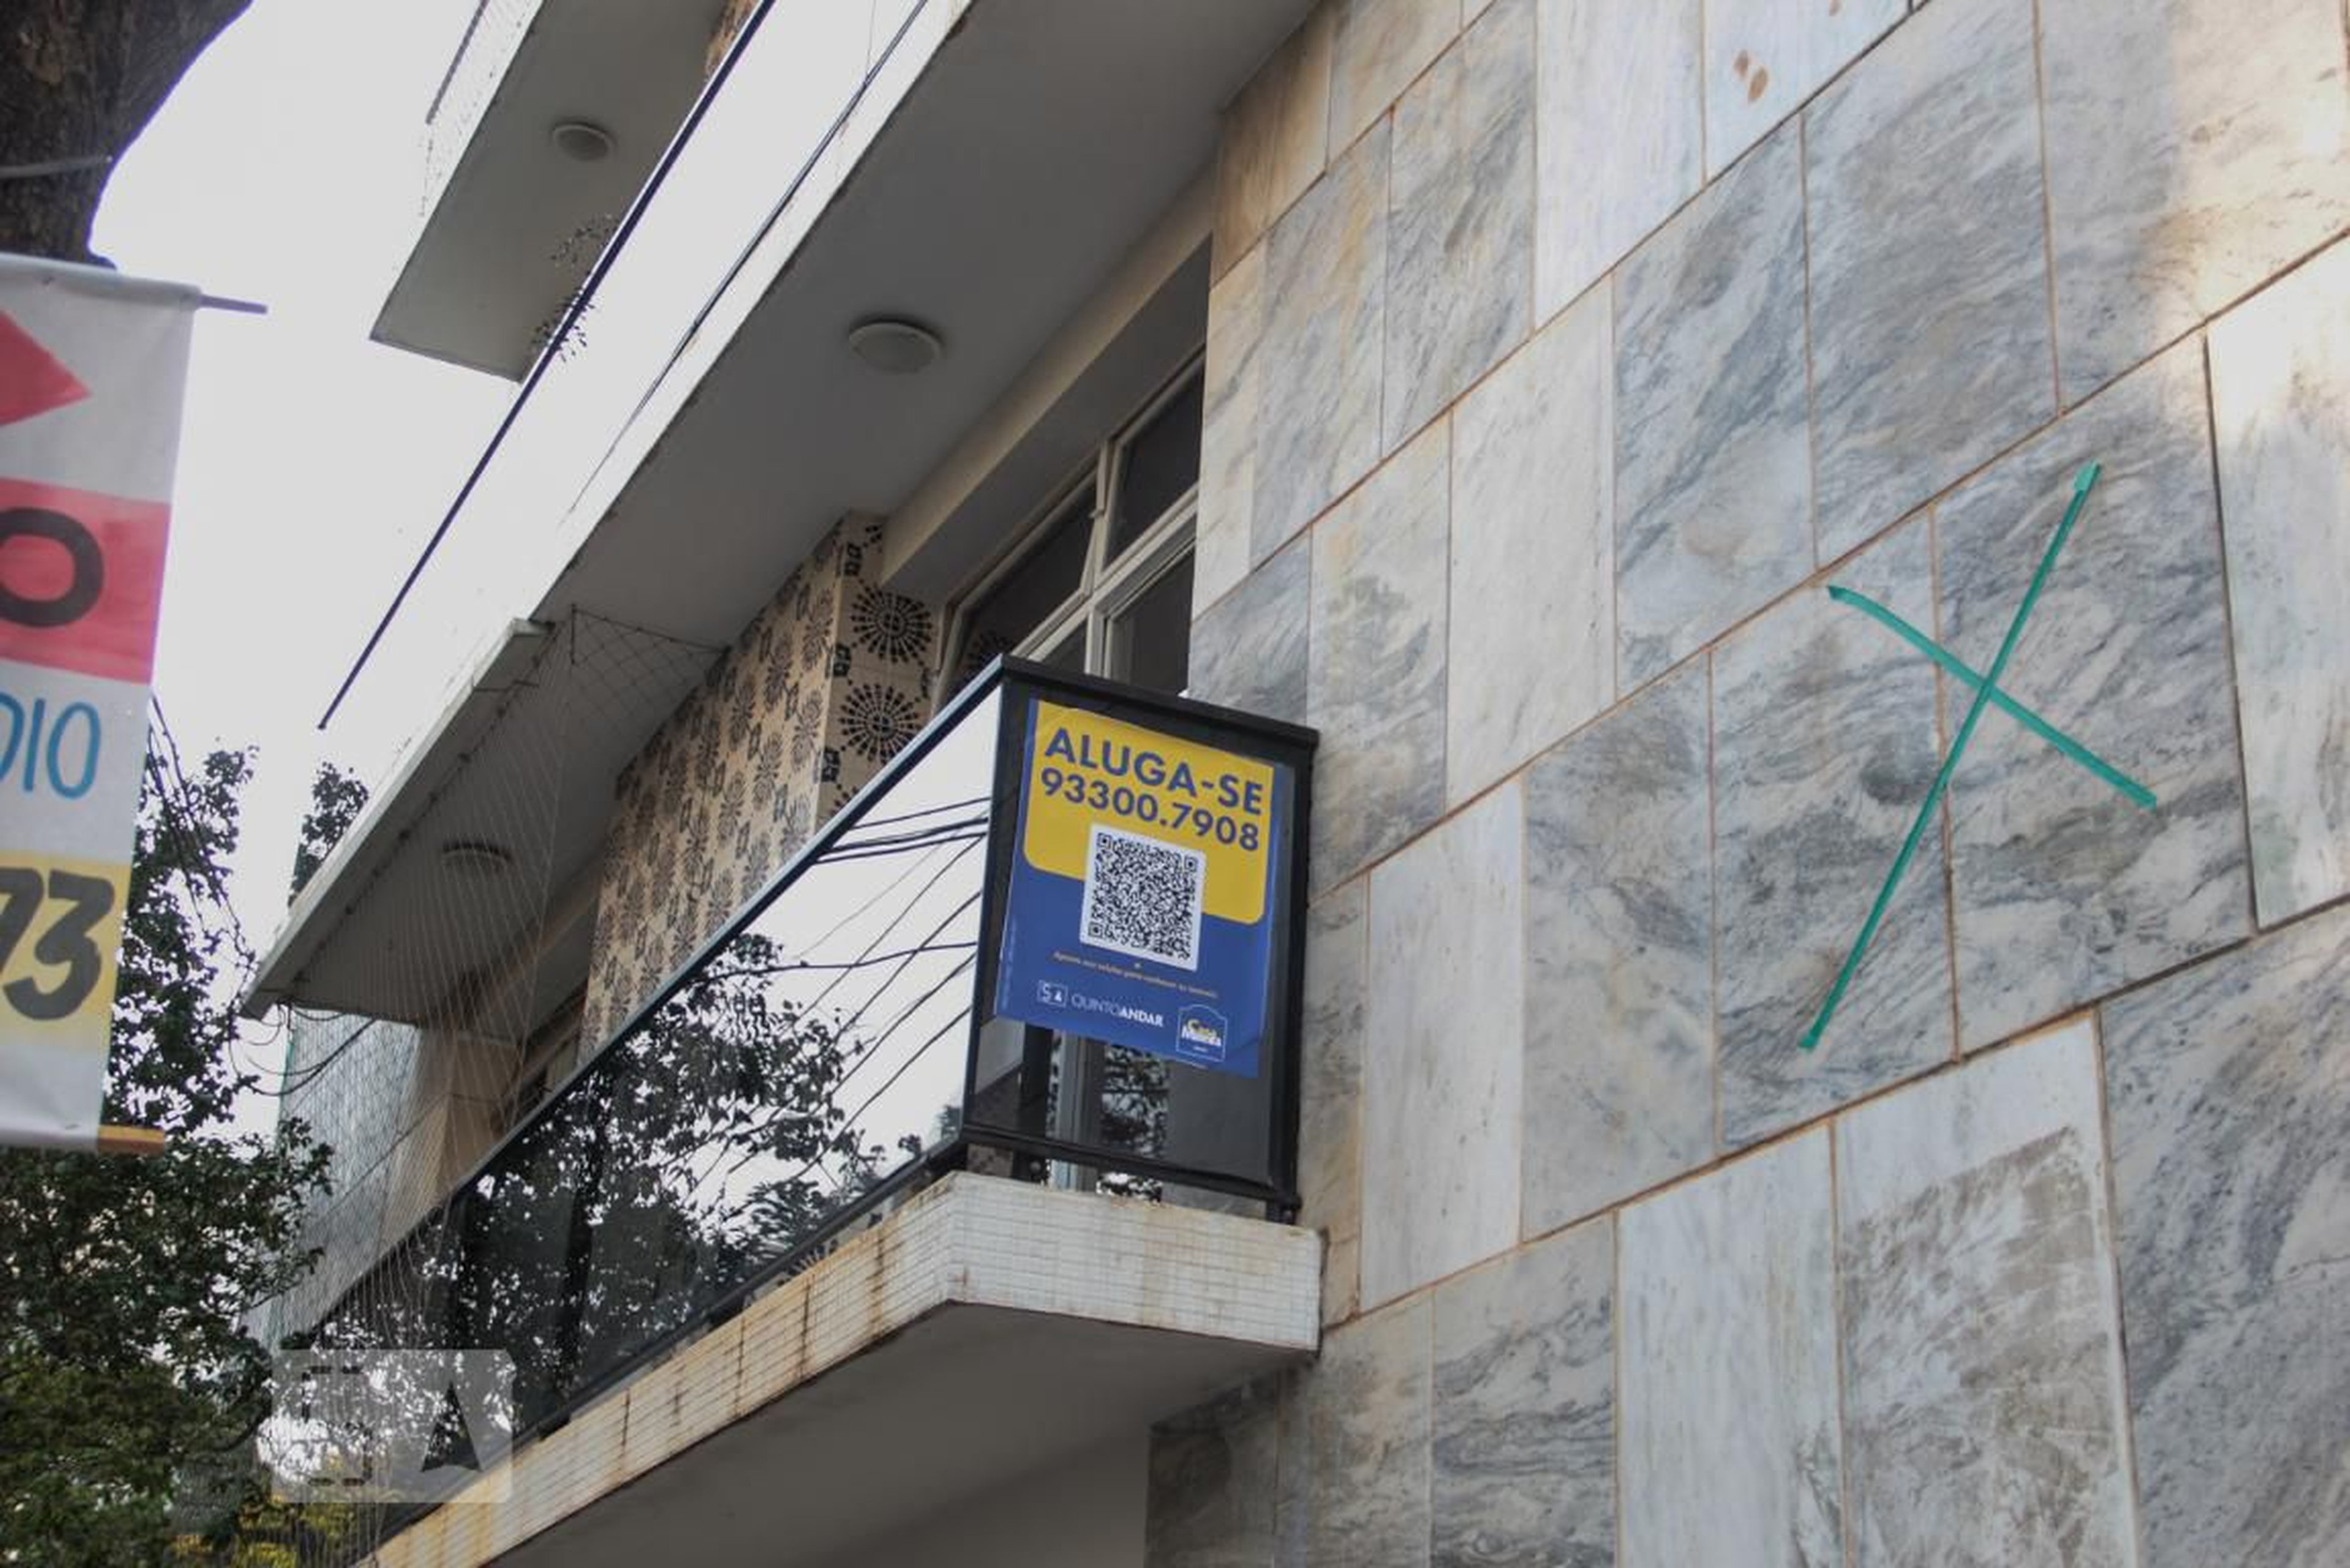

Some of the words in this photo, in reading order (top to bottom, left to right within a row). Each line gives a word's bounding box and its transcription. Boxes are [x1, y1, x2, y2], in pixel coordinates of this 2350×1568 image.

[1041, 767, 1259, 851] 93300.7908
[1044, 728, 1263, 815] ALUGA-SE
[1070, 993, 1164, 1028] QUINTOANDAR
